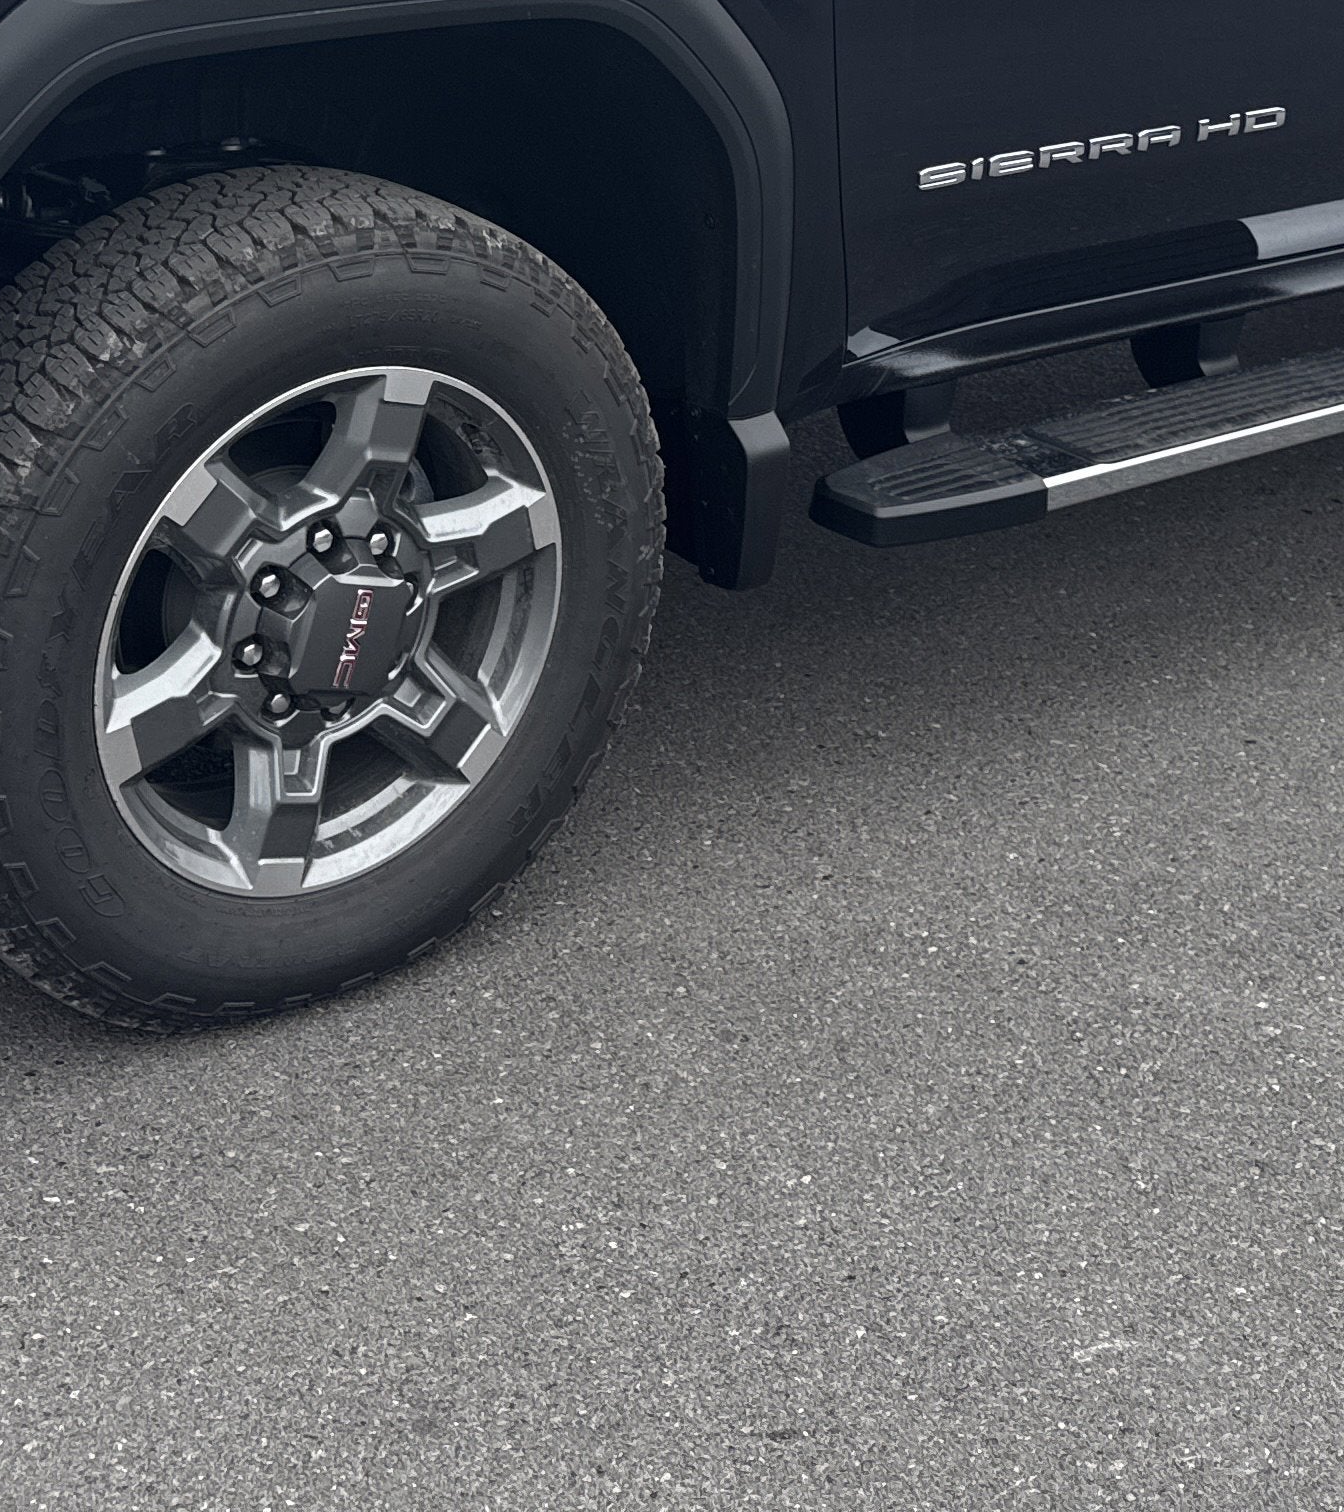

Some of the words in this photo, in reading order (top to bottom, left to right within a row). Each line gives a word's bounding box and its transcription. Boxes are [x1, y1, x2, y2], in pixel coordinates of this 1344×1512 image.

[918, 124, 1182, 191] SIERRA
[1196, 106, 1286, 143] HD
[332, 588, 374, 689] GMC
